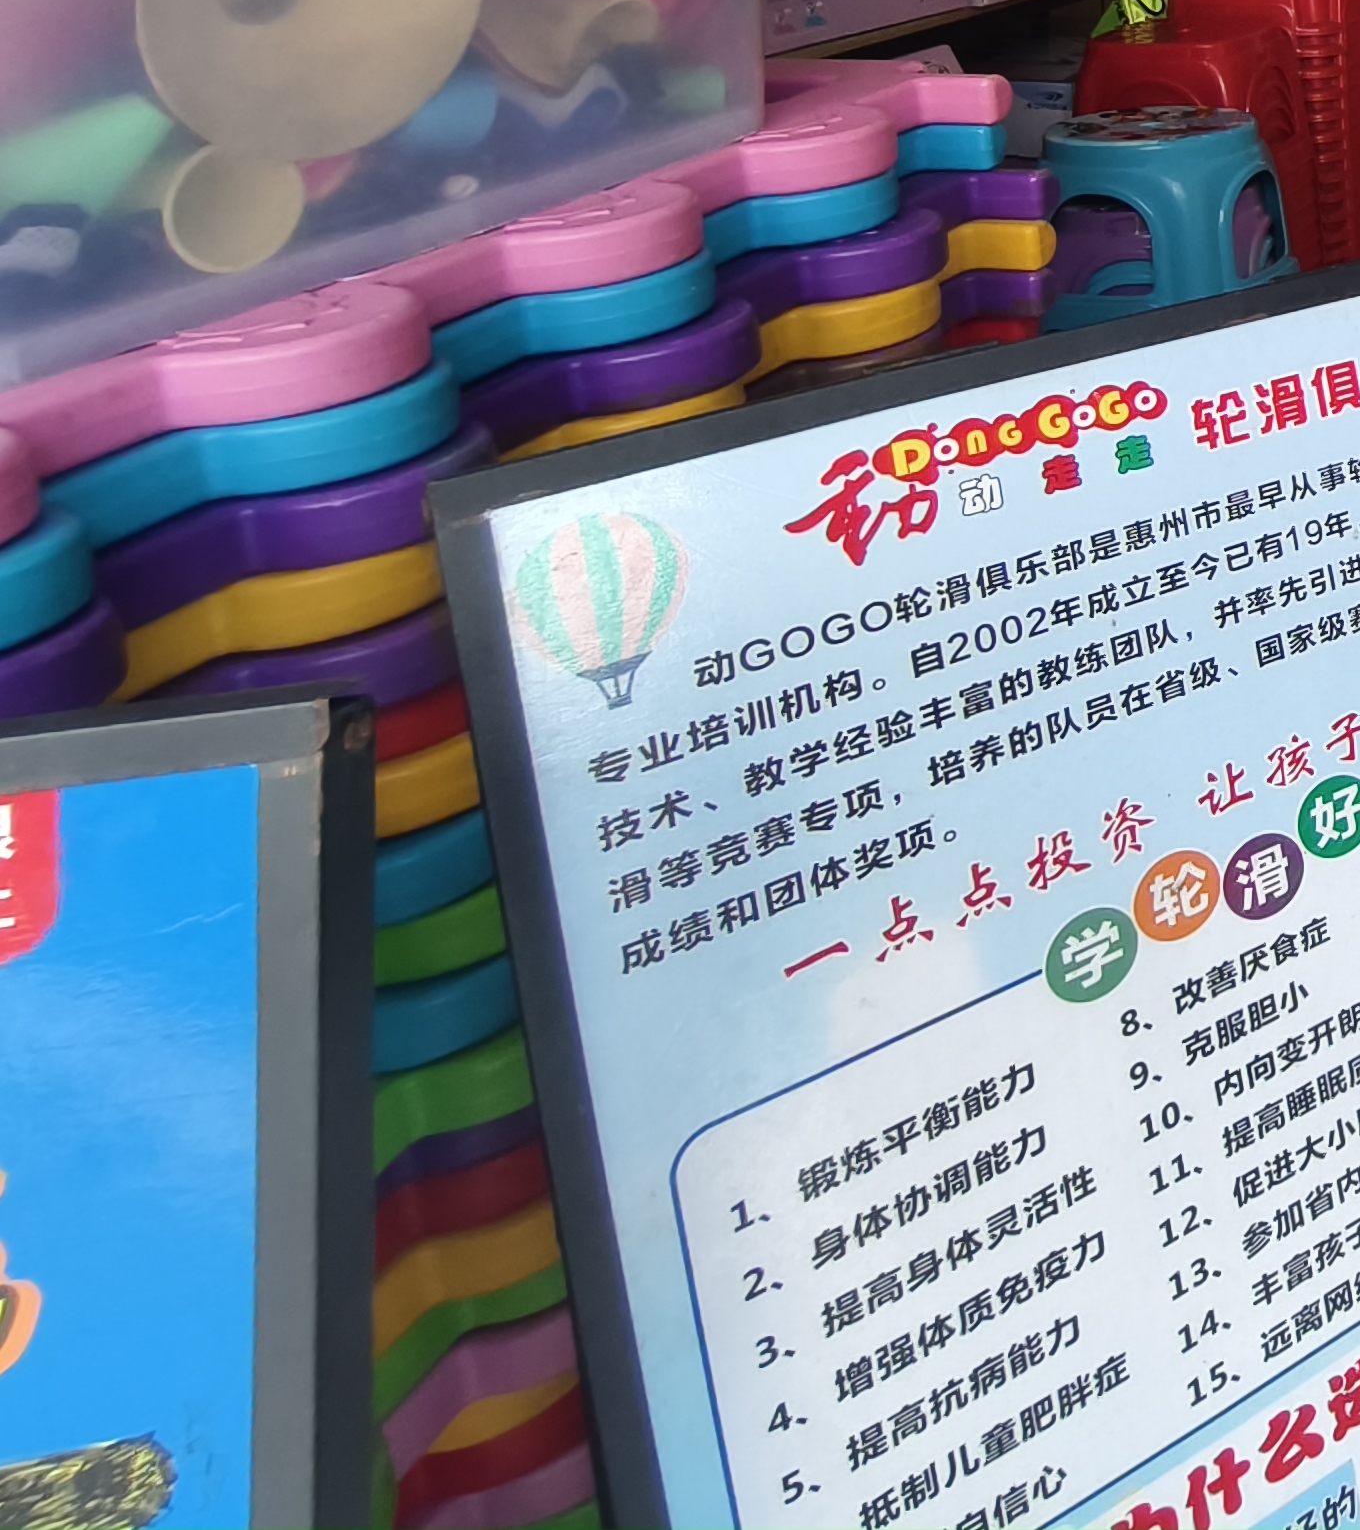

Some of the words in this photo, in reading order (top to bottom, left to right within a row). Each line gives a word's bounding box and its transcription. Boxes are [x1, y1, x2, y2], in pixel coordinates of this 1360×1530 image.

[620, 818, 958, 972] 成绩和团体奖项。
[780, 796, 1157, 984] 一点点投资
[1172, 916, 1332, 1015] 改善厌食症
[1181, 980, 1310, 1067] 克服胆小
[797, 1062, 1036, 1203] 锻炼平衡能力
[811, 1124, 1047, 1270] 身体协调能力
[820, 1164, 1098, 1339] 提高身体灵活性
[834, 1230, 1106, 1404] 增强体质免疫力
[845, 1314, 1081, 1473] 提高抗病能力
[859, 1351, 1131, 1530] 抵制儿童肥胖症
